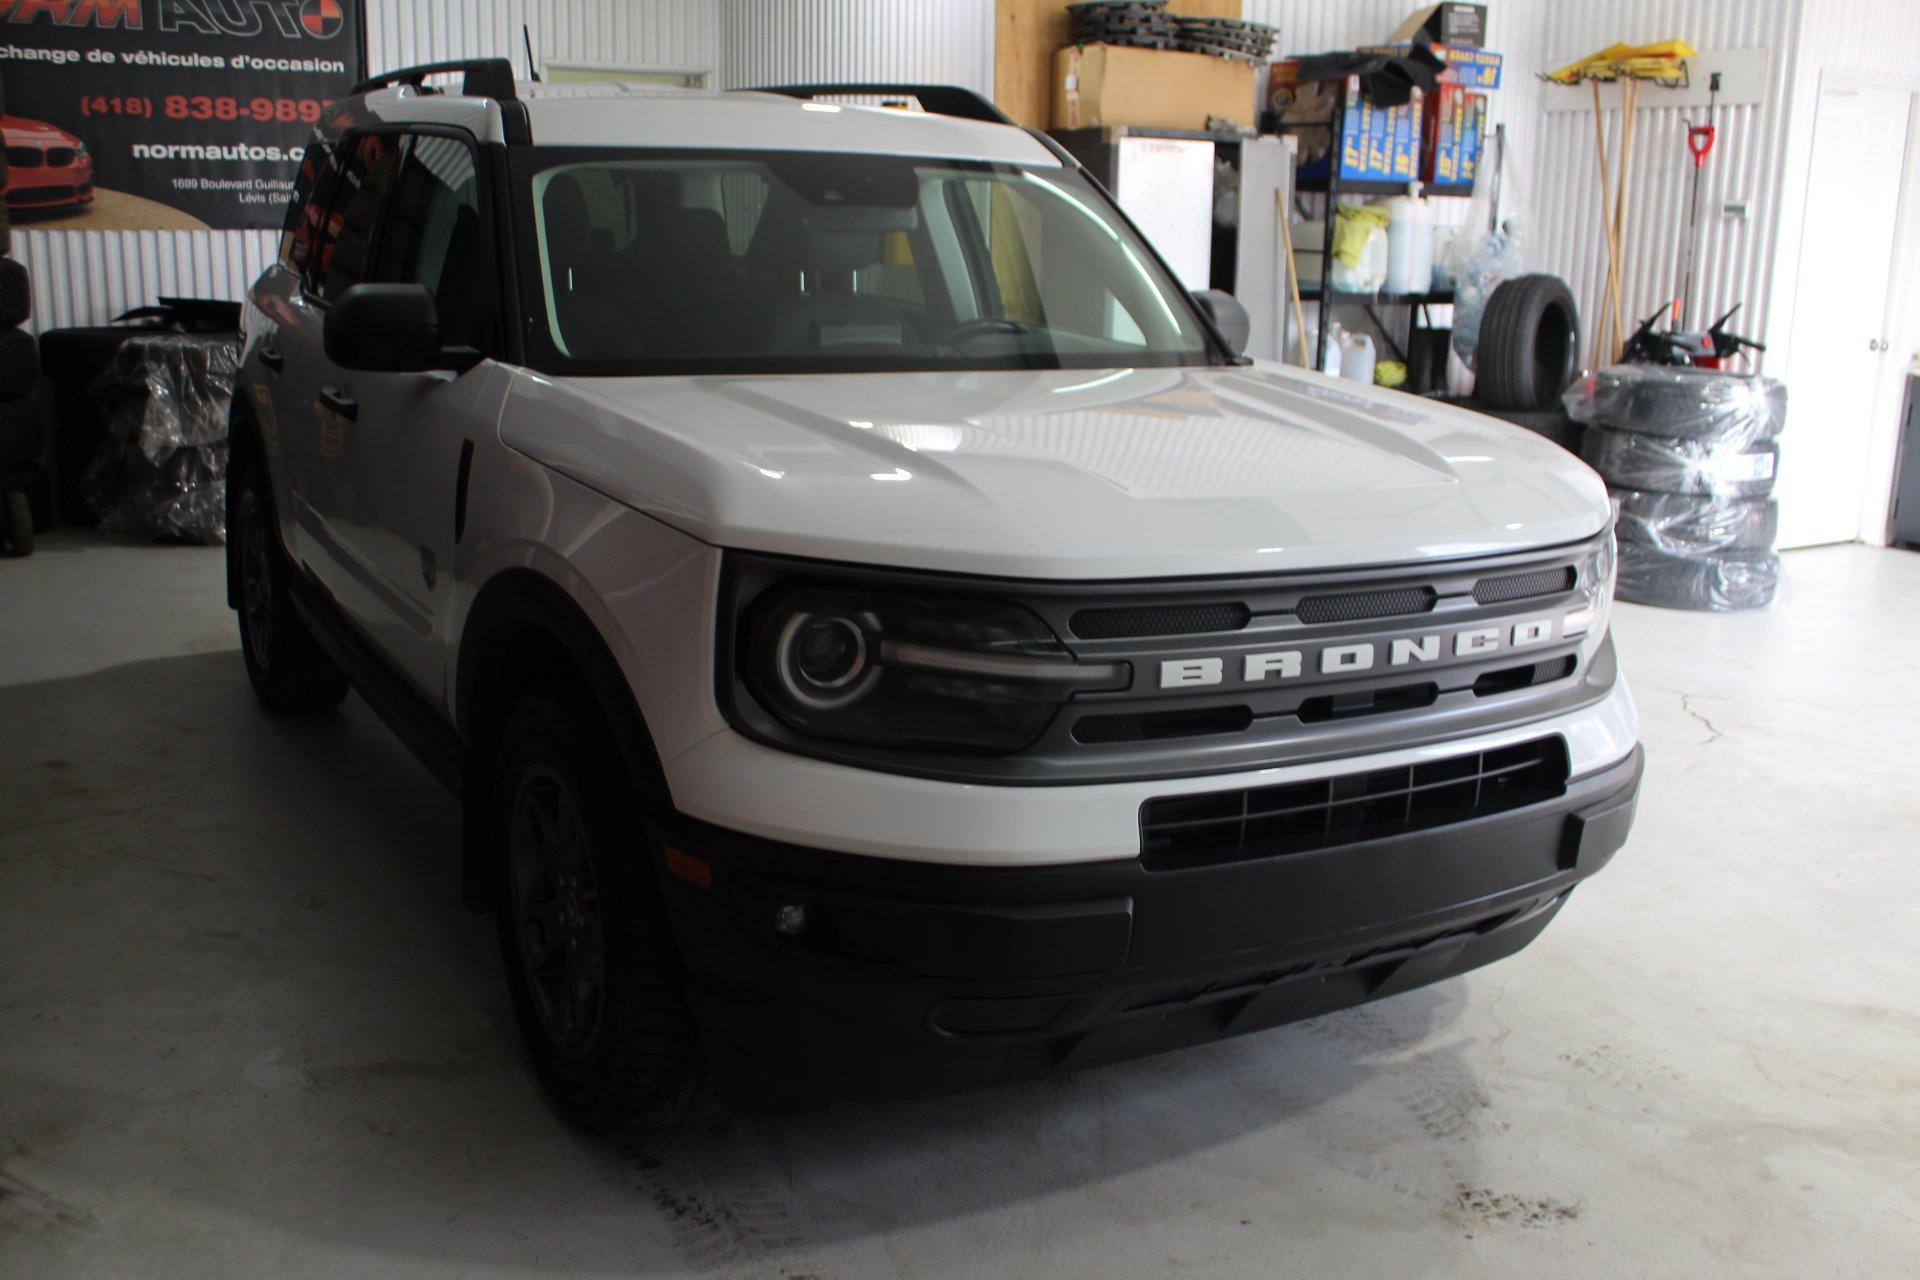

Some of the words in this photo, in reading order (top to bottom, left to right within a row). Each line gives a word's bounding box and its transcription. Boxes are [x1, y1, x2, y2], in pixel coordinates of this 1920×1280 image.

[86, 49, 115, 63] de
[121, 50, 225, 68] véhicules
[231, 54, 345, 73] d'occasion
[81, 95, 153, 119] (418)
[201, 178, 253, 190] Boulevard
[239, 192, 266, 204] Lévis
[1160, 618, 1552, 689] BRONCO
